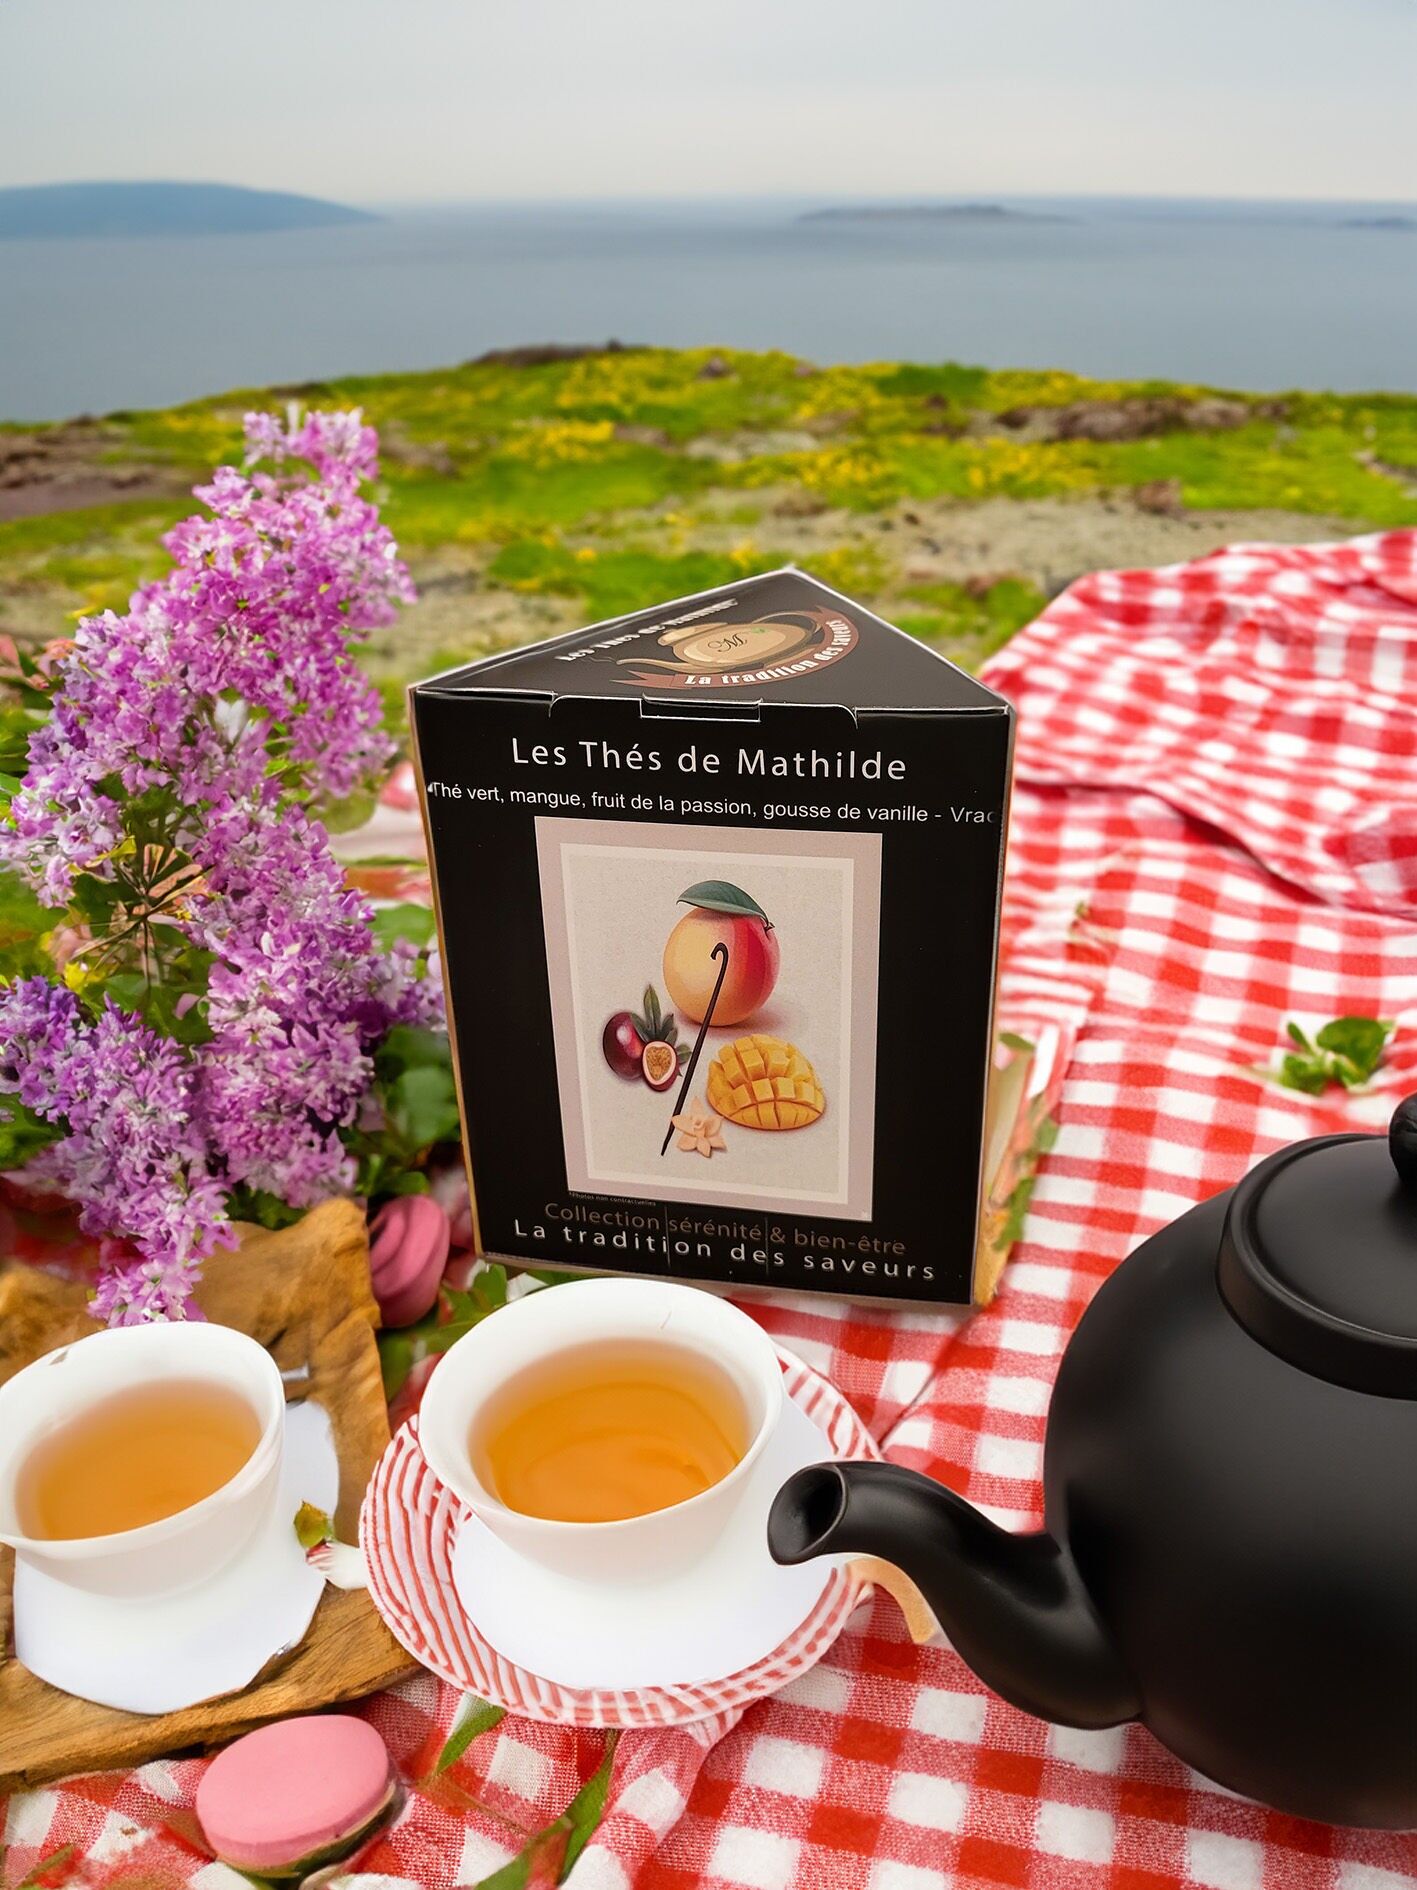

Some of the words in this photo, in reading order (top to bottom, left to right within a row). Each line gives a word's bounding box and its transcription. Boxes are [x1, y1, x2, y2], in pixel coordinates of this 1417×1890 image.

[684, 674, 713, 686] La
[721, 657, 819, 685] tradition
[511, 736, 568, 767] Les
[578, 740, 663, 772] Thés
[677, 744, 721, 775] de
[736, 747, 908, 781] Mathilde
[466, 786, 504, 803] vert,
[509, 788, 587, 809] mangue,
[591, 791, 626, 809] fruit
[630, 792, 653, 811] de
[658, 796, 675, 811] la
[680, 797, 758, 818] passion,
[762, 802, 832, 820] gousse
[836, 803, 862, 820] de
[866, 806, 929, 823] vanille
[513, 1218, 547, 1240] La
[562, 1224, 712, 1259] tradition
[730, 1242, 786, 1268] des
[802, 1253, 936, 1281] saveurs
[544, 1202, 661, 1231] Collection
[668, 1216, 763, 1242] sérénité
[769, 1225, 787, 1245] &
[793, 1227, 908, 1256] bien-être
